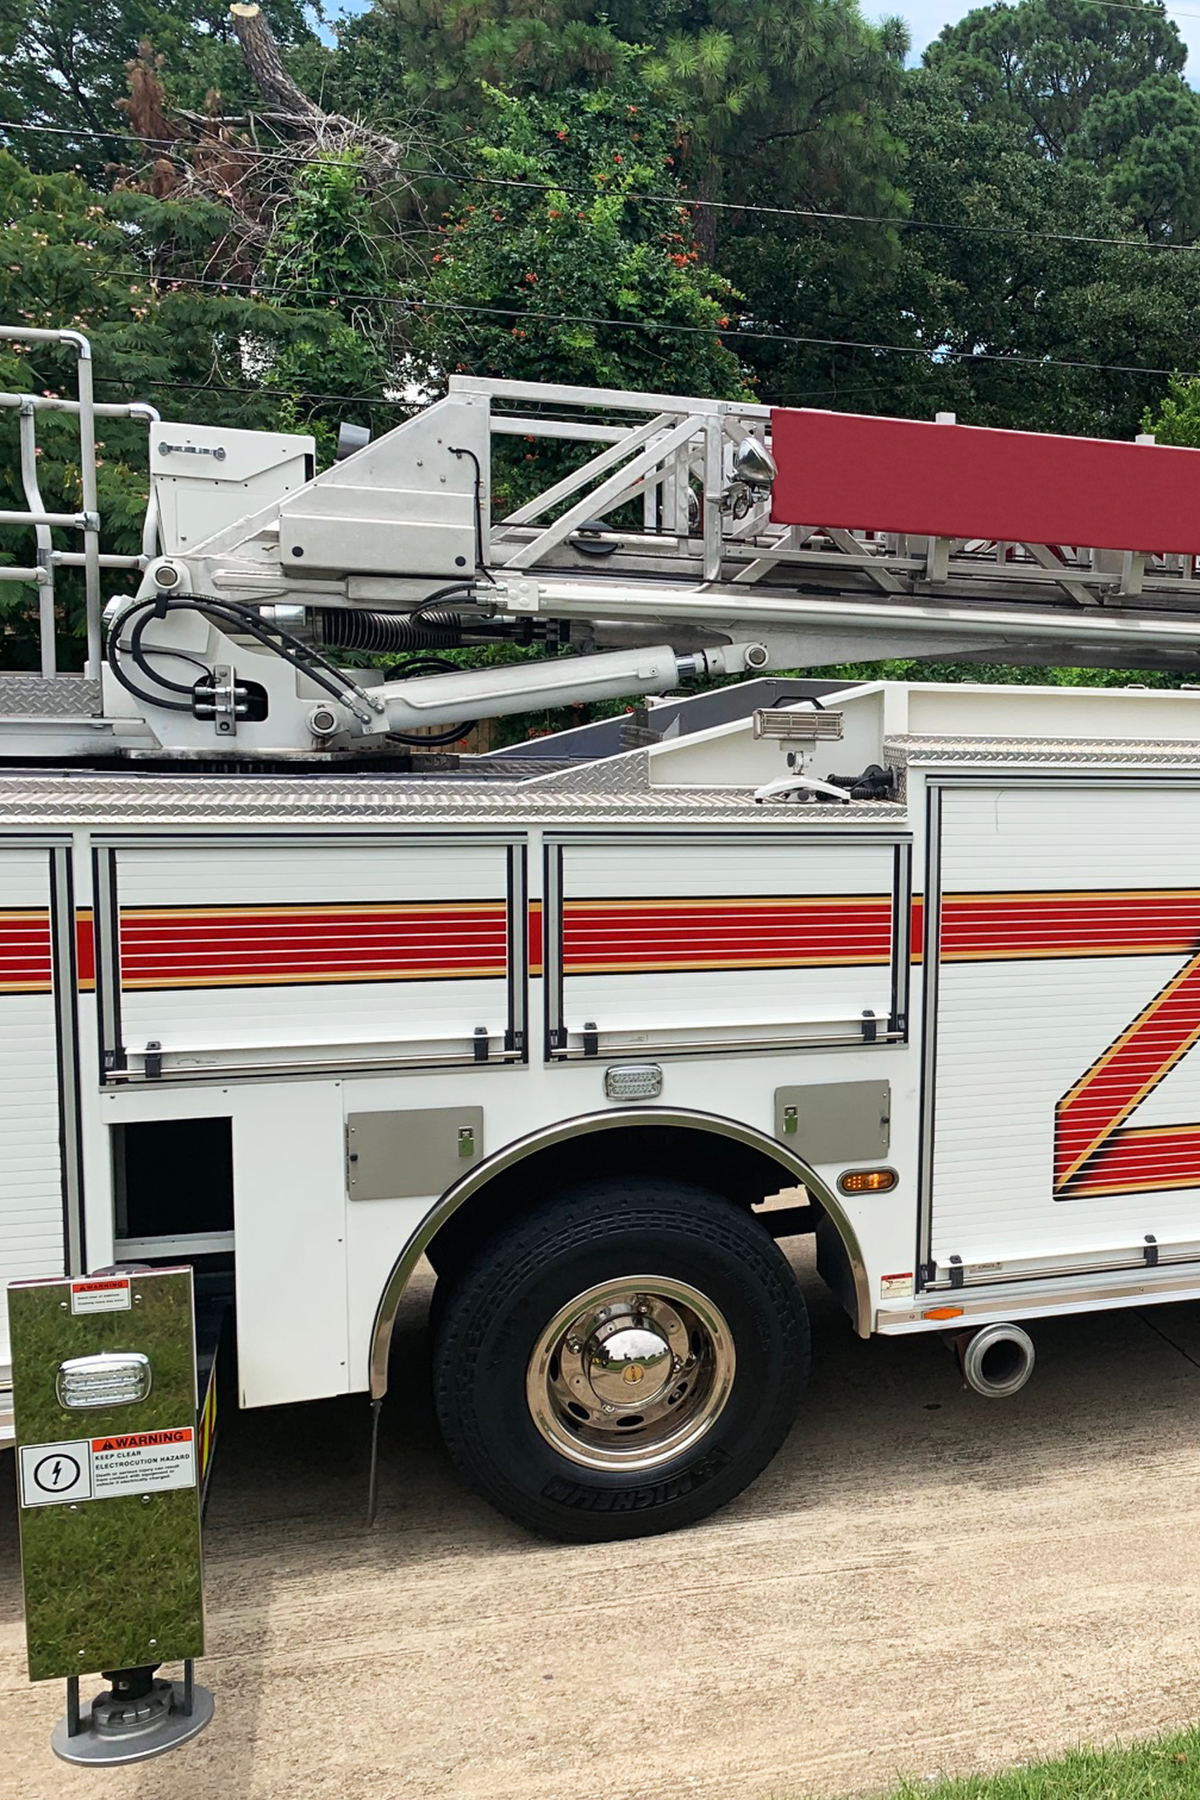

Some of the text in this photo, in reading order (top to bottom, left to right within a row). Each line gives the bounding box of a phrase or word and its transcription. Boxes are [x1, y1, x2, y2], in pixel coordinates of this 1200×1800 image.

[115, 1431, 184, 1448] WARNING
[95, 1453, 190, 1470] ELECTROCUTION HAZARD
[116, 1450, 142, 1459] CLEAR
[543, 1474, 693, 1511] MICHELIN
